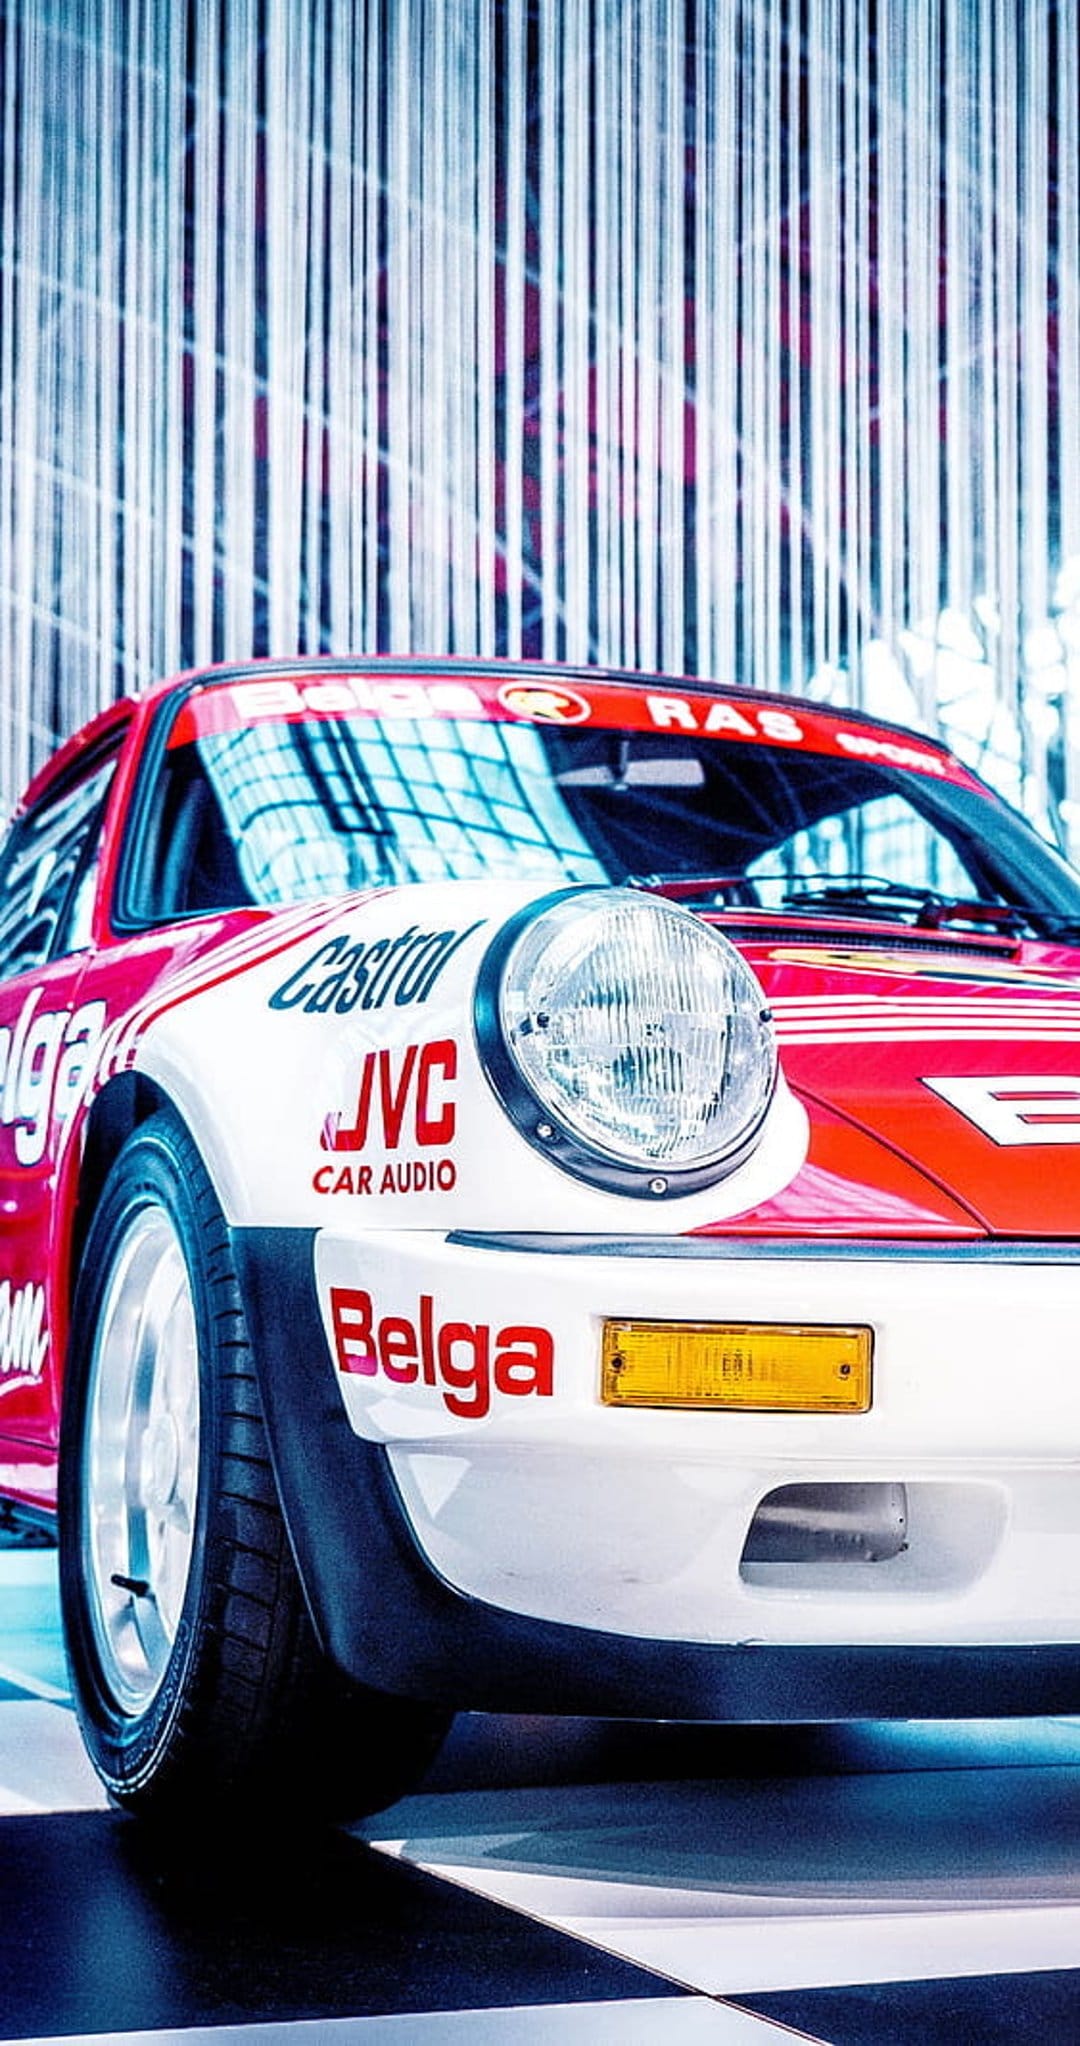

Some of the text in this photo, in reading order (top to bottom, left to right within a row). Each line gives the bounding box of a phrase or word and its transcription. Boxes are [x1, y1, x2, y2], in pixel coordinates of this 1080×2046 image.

[231, 677, 484, 719] Belga
[646, 696, 804, 742] RAS
[268, 918, 489, 1014] Castrol
[320, 1038, 457, 1152] JVC
[312, 1159, 457, 1195] CAR AUDIO
[329, 1286, 555, 1420] Belga
